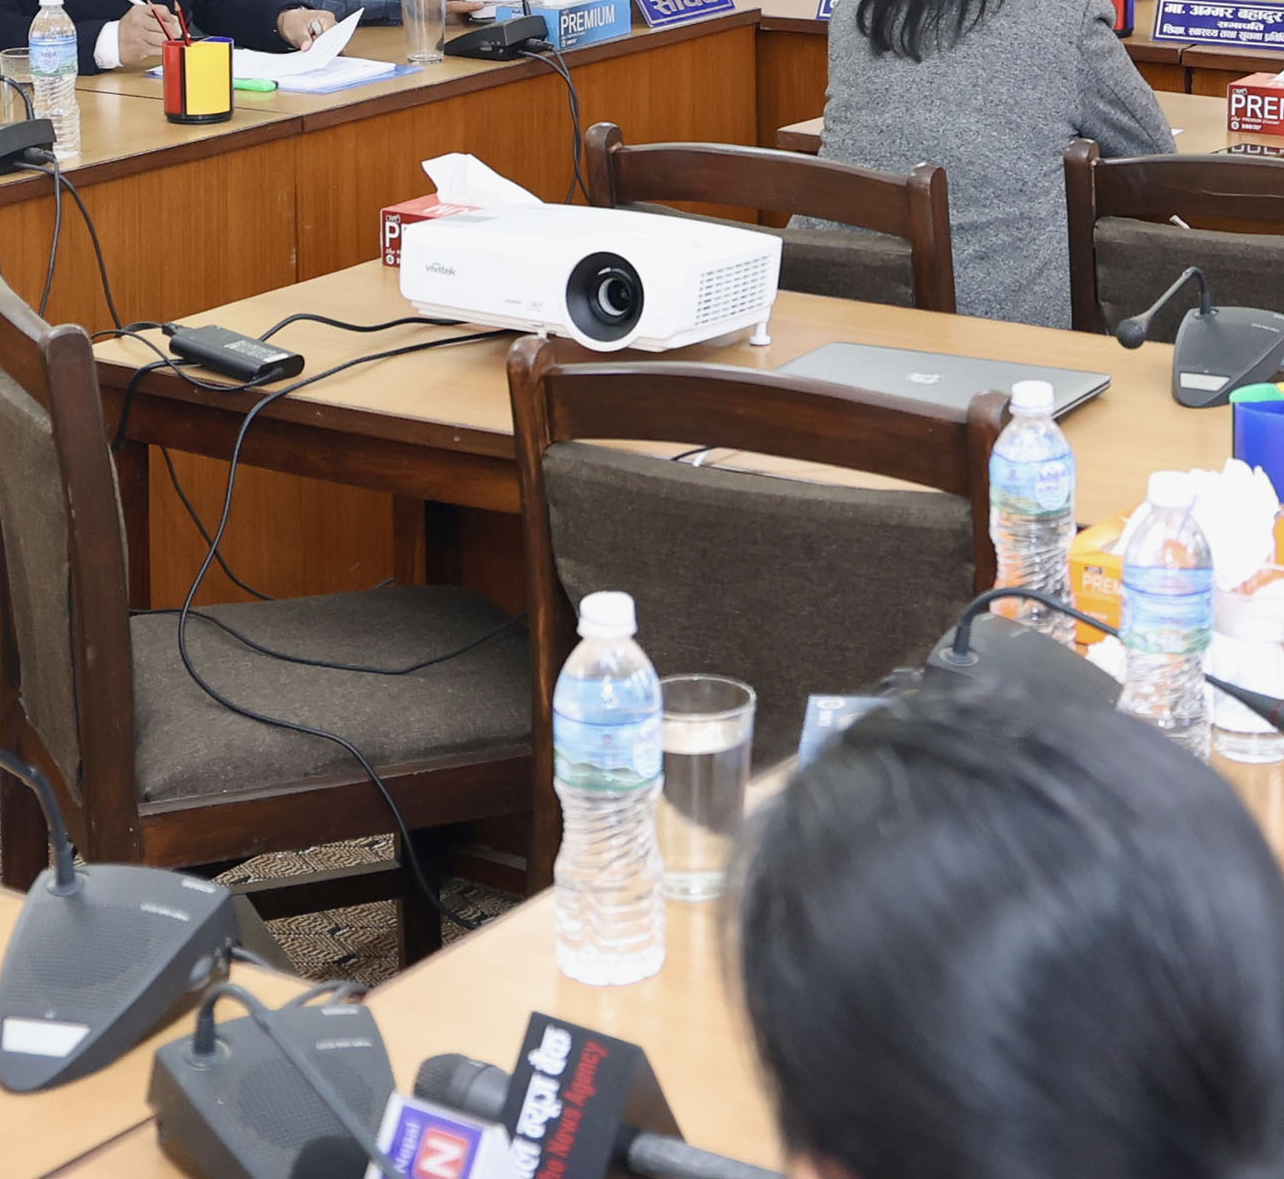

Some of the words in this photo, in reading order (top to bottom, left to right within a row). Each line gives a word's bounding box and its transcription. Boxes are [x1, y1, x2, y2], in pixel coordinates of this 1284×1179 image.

[560, 5, 615, 35] PREMIUM
[1238, 8, 1284, 24] बहादुर
[425, 263, 456, 276] vivitek
[564, 1040, 610, 1108] Agency
[394, 1121, 421, 1174] Nepal
[547, 1106, 583, 1158] News
[420, 1137, 470, 1179] N
